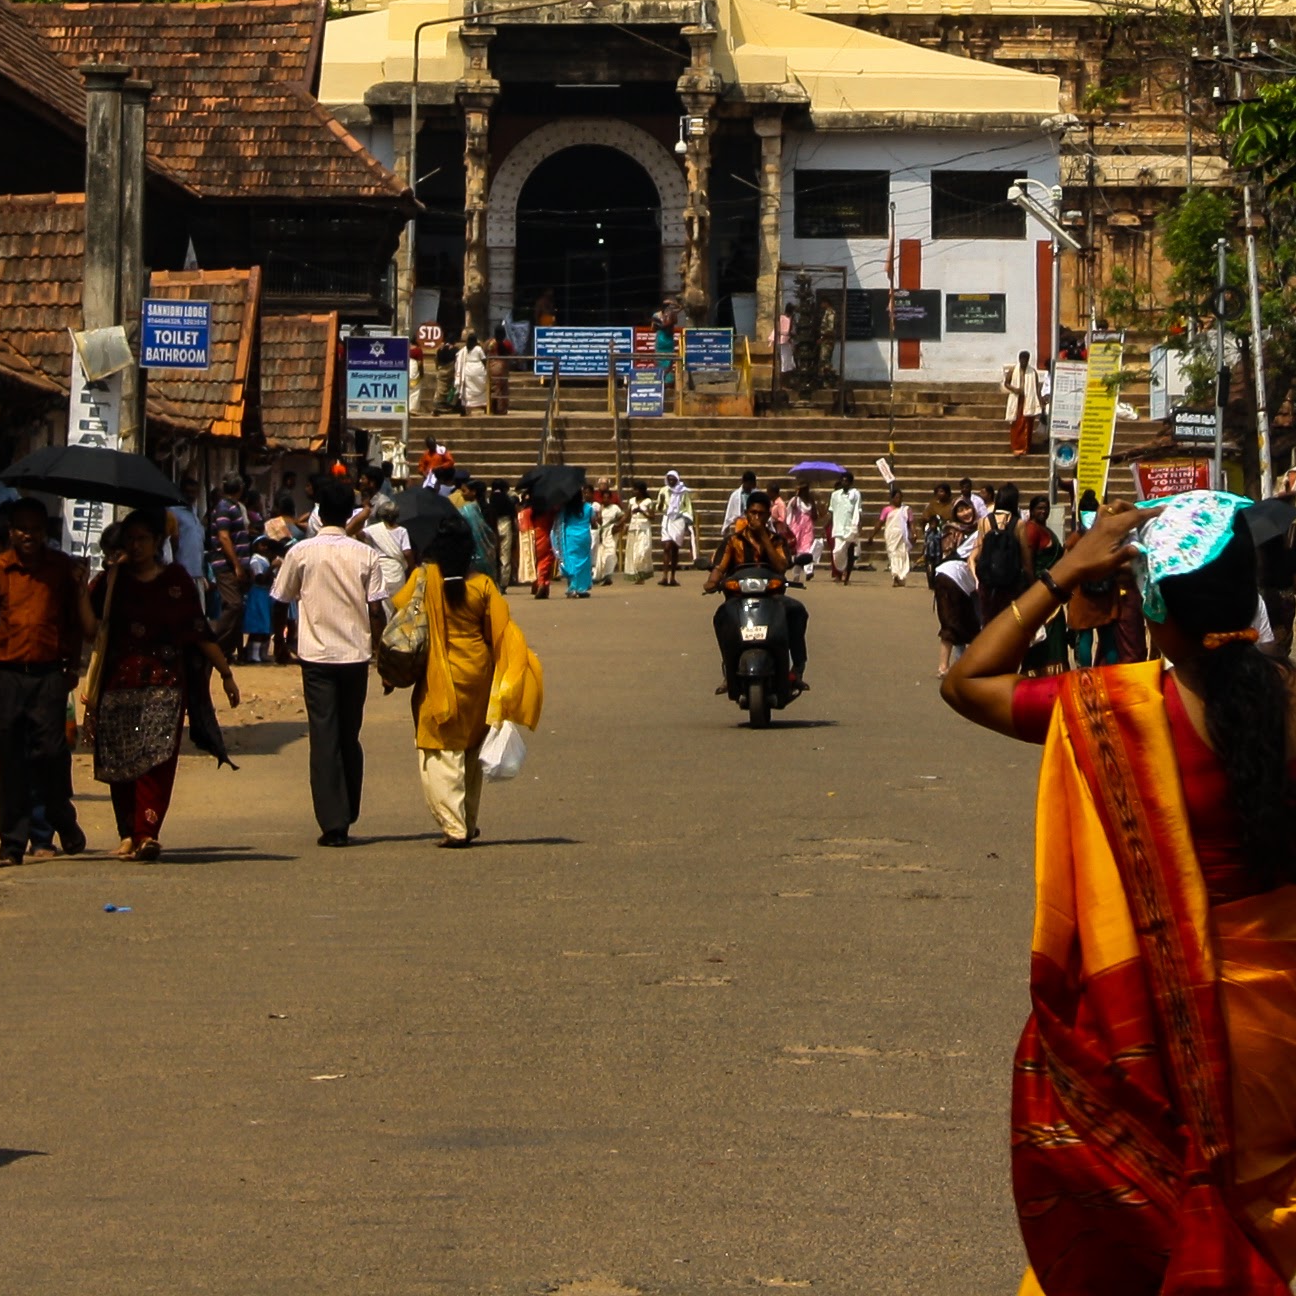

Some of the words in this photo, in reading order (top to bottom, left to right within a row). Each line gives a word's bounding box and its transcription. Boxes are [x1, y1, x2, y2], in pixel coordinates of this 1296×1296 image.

[147, 304, 184, 317] SANNIDHI
[184, 306, 208, 318] LODGE
[153, 330, 199, 345] TOILET
[418, 325, 441, 340] STD
[145, 347, 206, 363] BATHROOM
[350, 371, 401, 381] Moneyplant
[356, 383, 398, 398] ATM
[1151, 478, 1194, 486] TOILET
